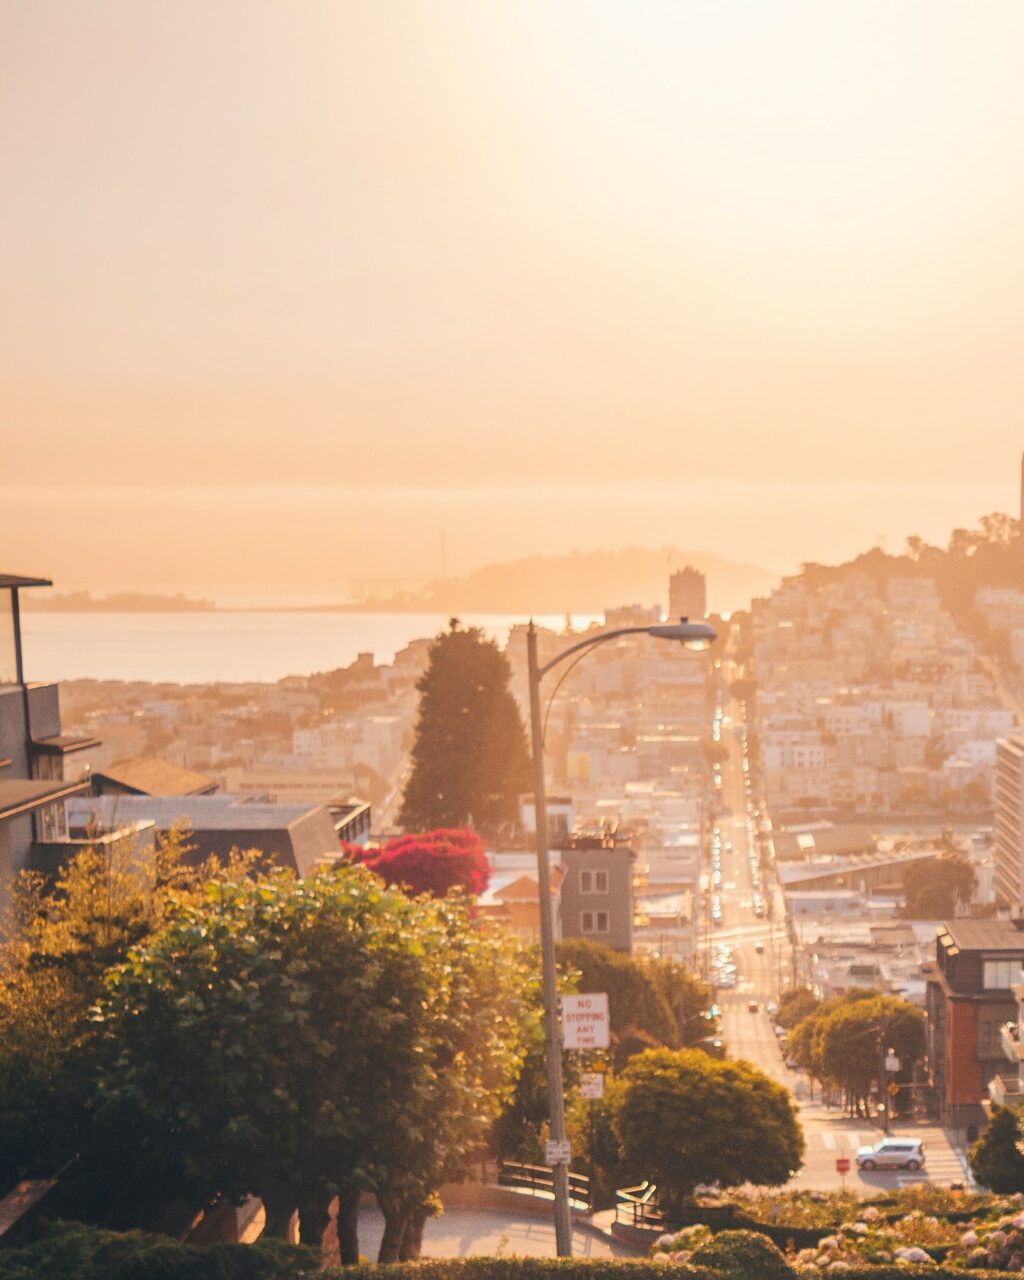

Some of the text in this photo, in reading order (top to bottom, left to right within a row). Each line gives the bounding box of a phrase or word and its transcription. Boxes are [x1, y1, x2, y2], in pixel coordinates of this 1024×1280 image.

[577, 999, 592, 1008] NO
[566, 1012, 605, 1022] STOPPING
[577, 1025, 594, 1033] ANY
